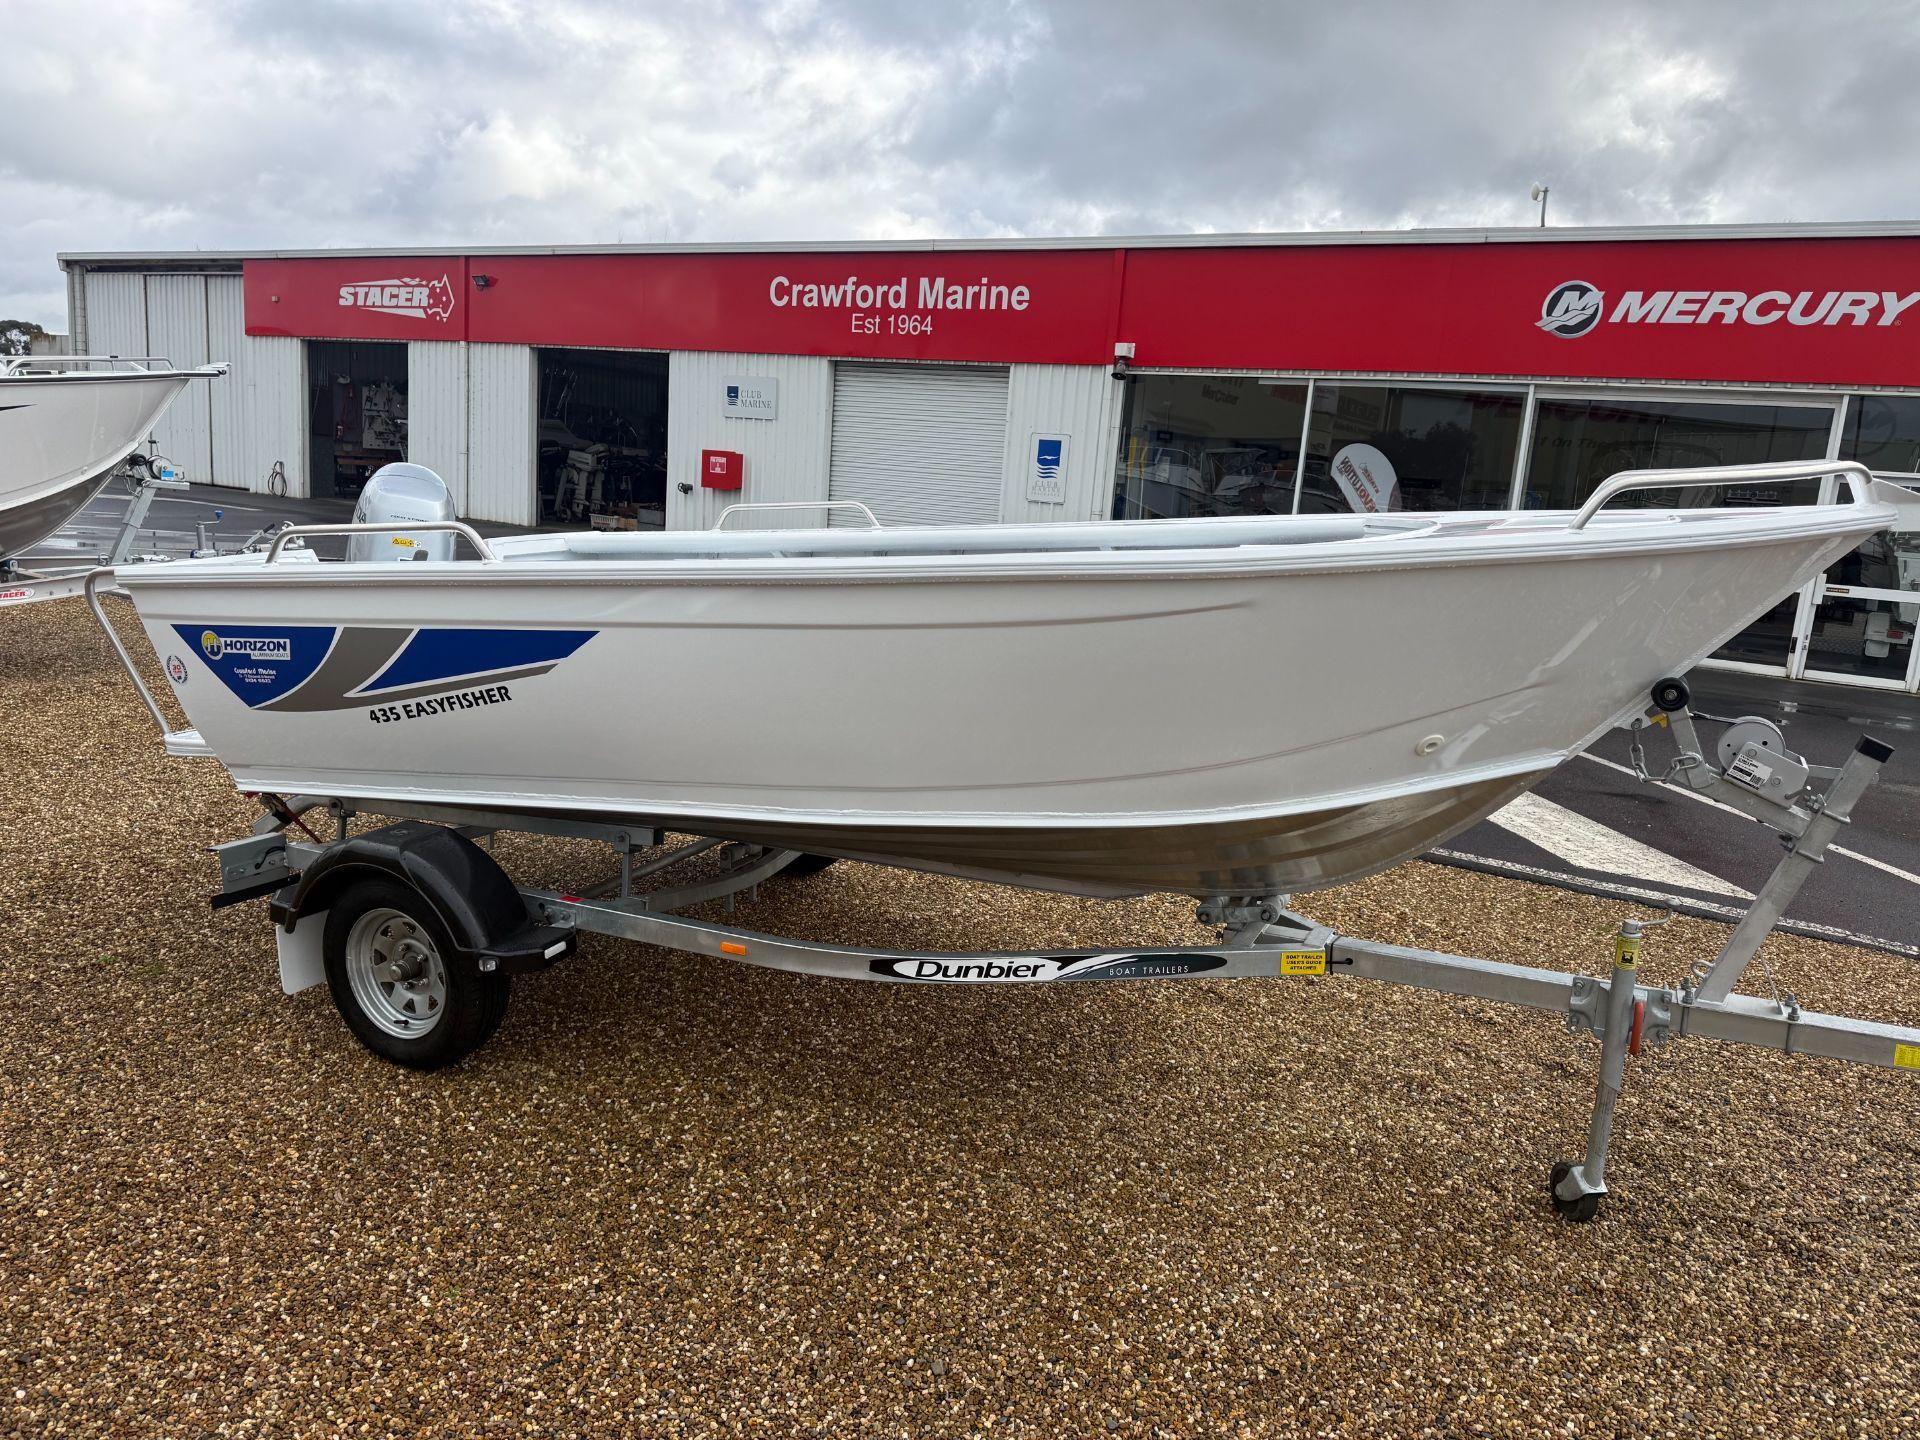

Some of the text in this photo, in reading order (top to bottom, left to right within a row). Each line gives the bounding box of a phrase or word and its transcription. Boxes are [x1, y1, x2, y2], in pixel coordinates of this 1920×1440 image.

[338, 286, 430, 307] STACER
[769, 275, 1030, 310] Crawford Marine
[1608, 290, 1920, 327] MERCURY
[851, 313, 933, 335] Est 1964
[740, 390, 762, 399] CLUB
[740, 399, 772, 409] MARINE
[0, 591, 26, 599] TACER
[223, 639, 287, 652] HORIZON
[369, 686, 513, 723] 435 EASYFISHER
[915, 960, 1190, 979] Dunbier BOAT TRAILERS
